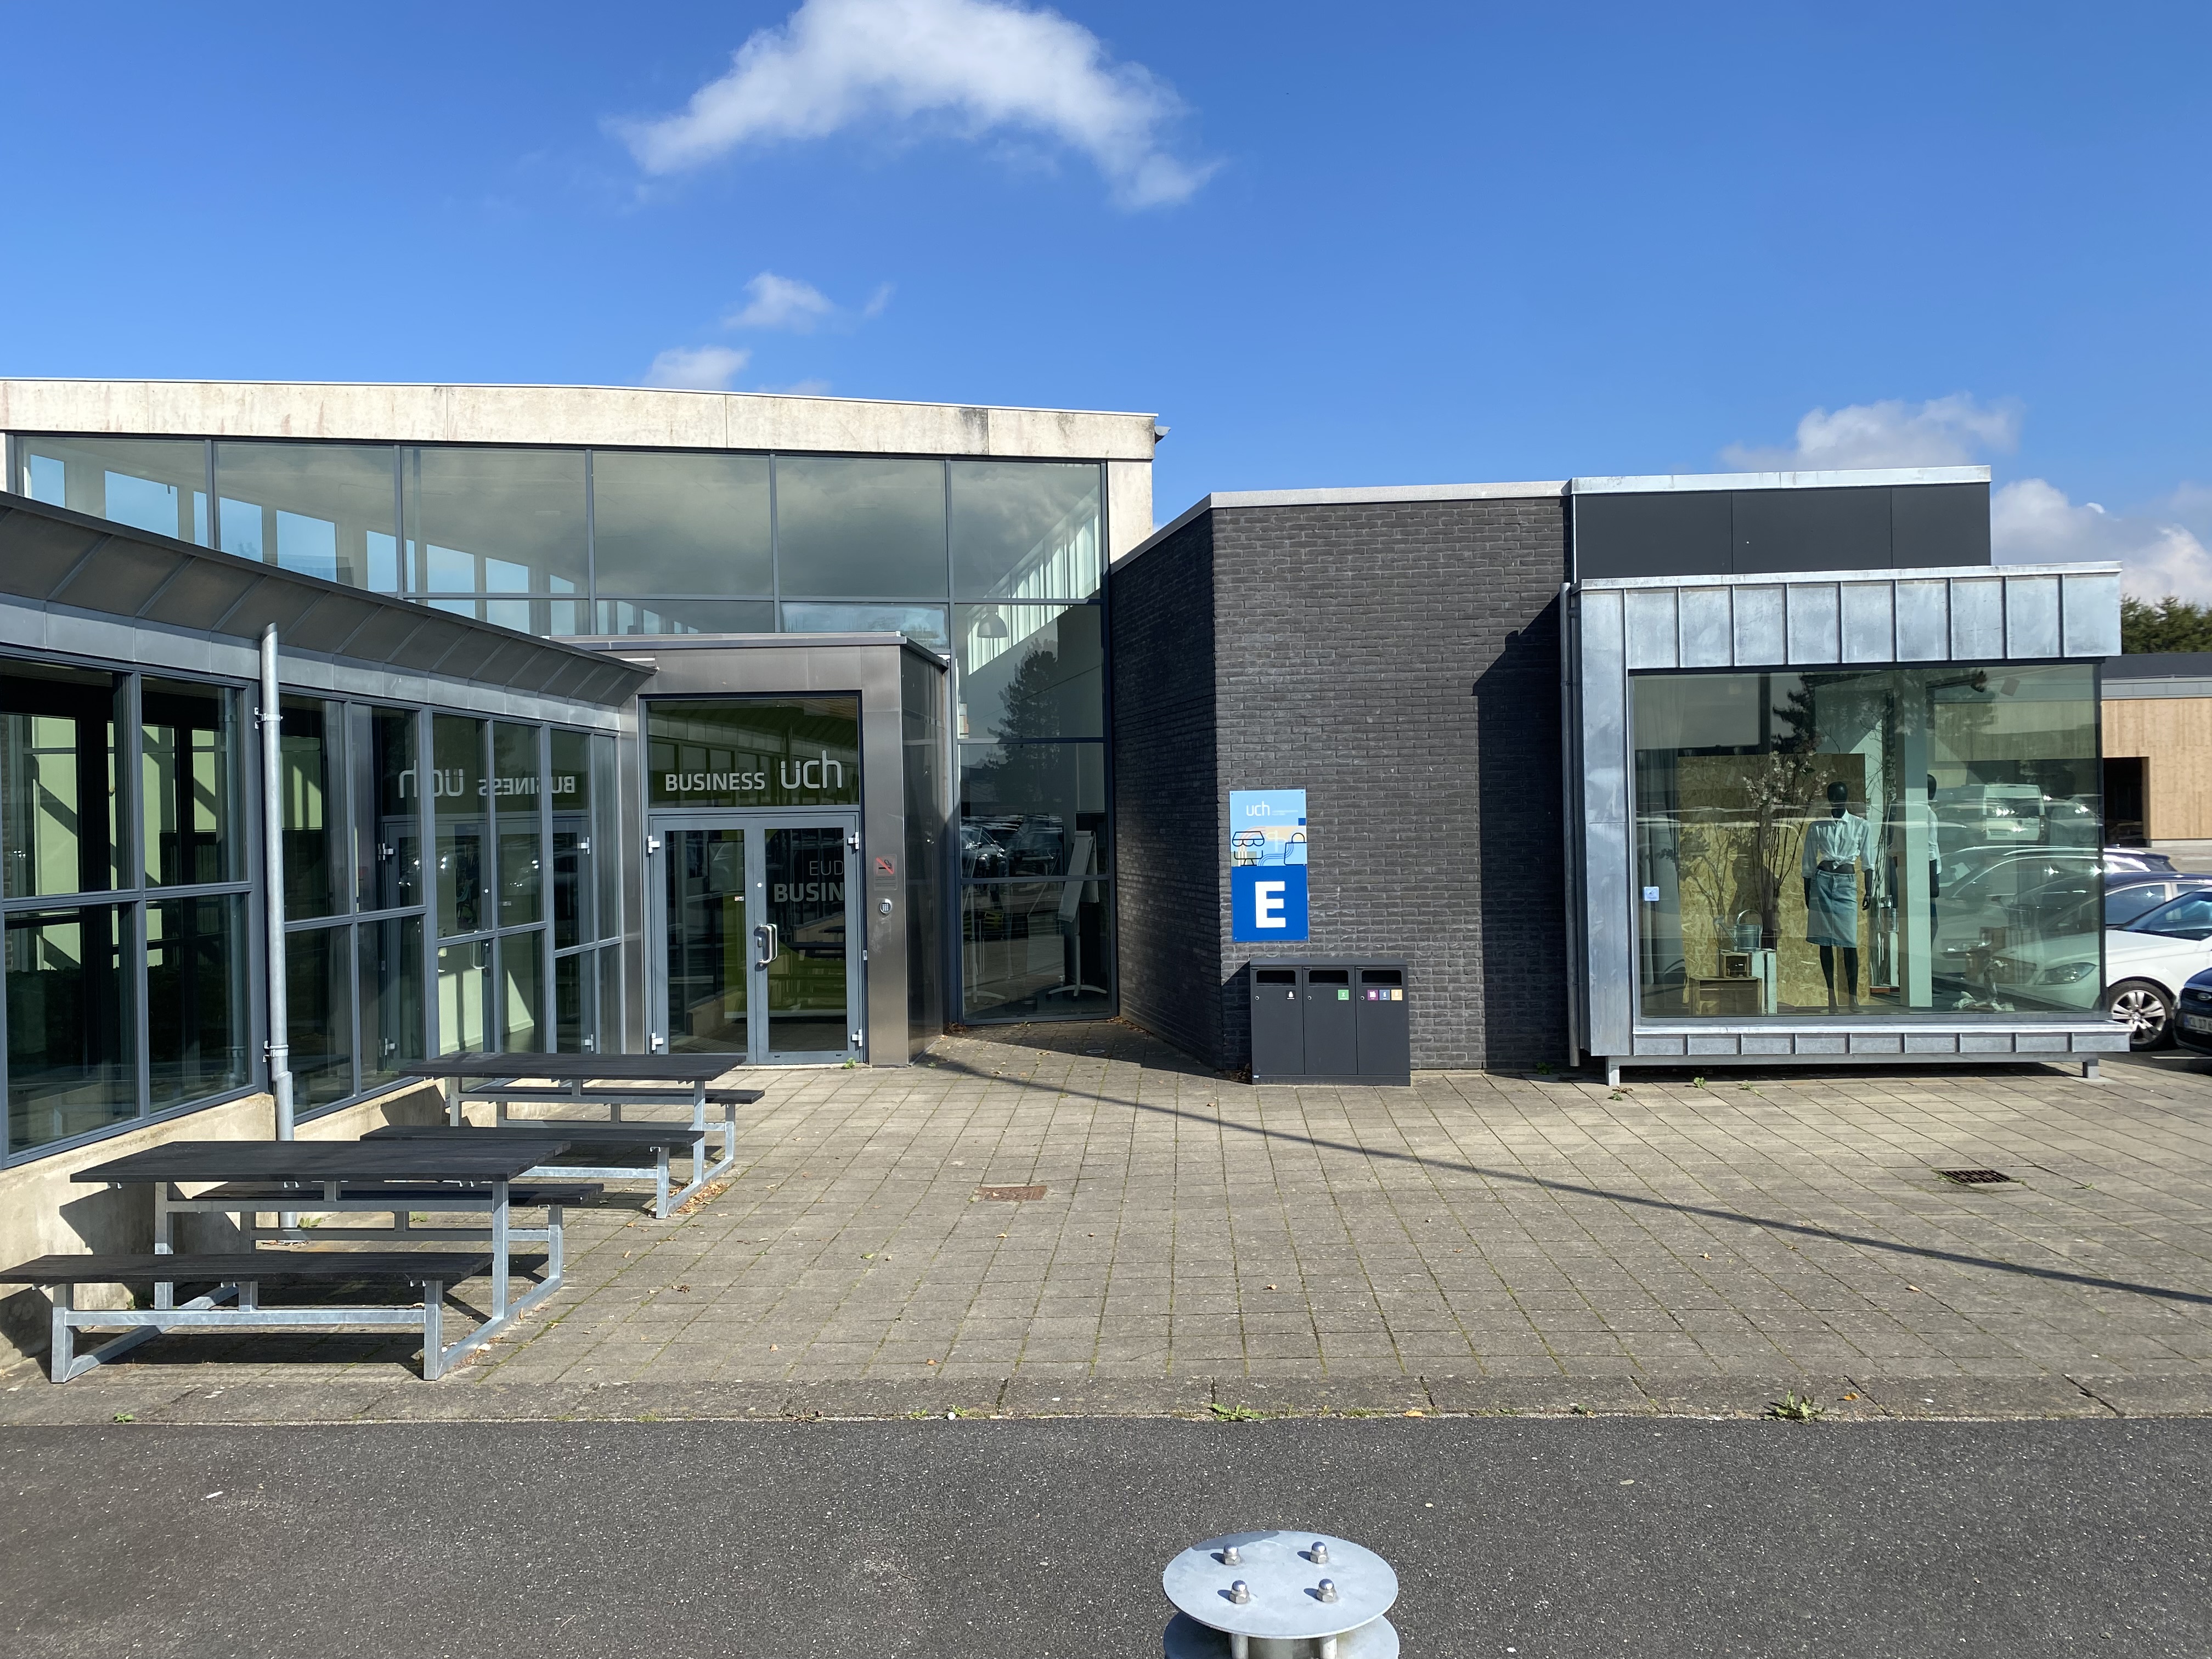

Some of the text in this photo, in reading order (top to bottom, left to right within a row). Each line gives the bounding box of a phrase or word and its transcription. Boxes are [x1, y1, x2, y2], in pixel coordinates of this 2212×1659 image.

[665, 750, 842, 791] BUSINESS uch
[1246, 801, 1270, 816] uch
[1255, 881, 1286, 928] E
